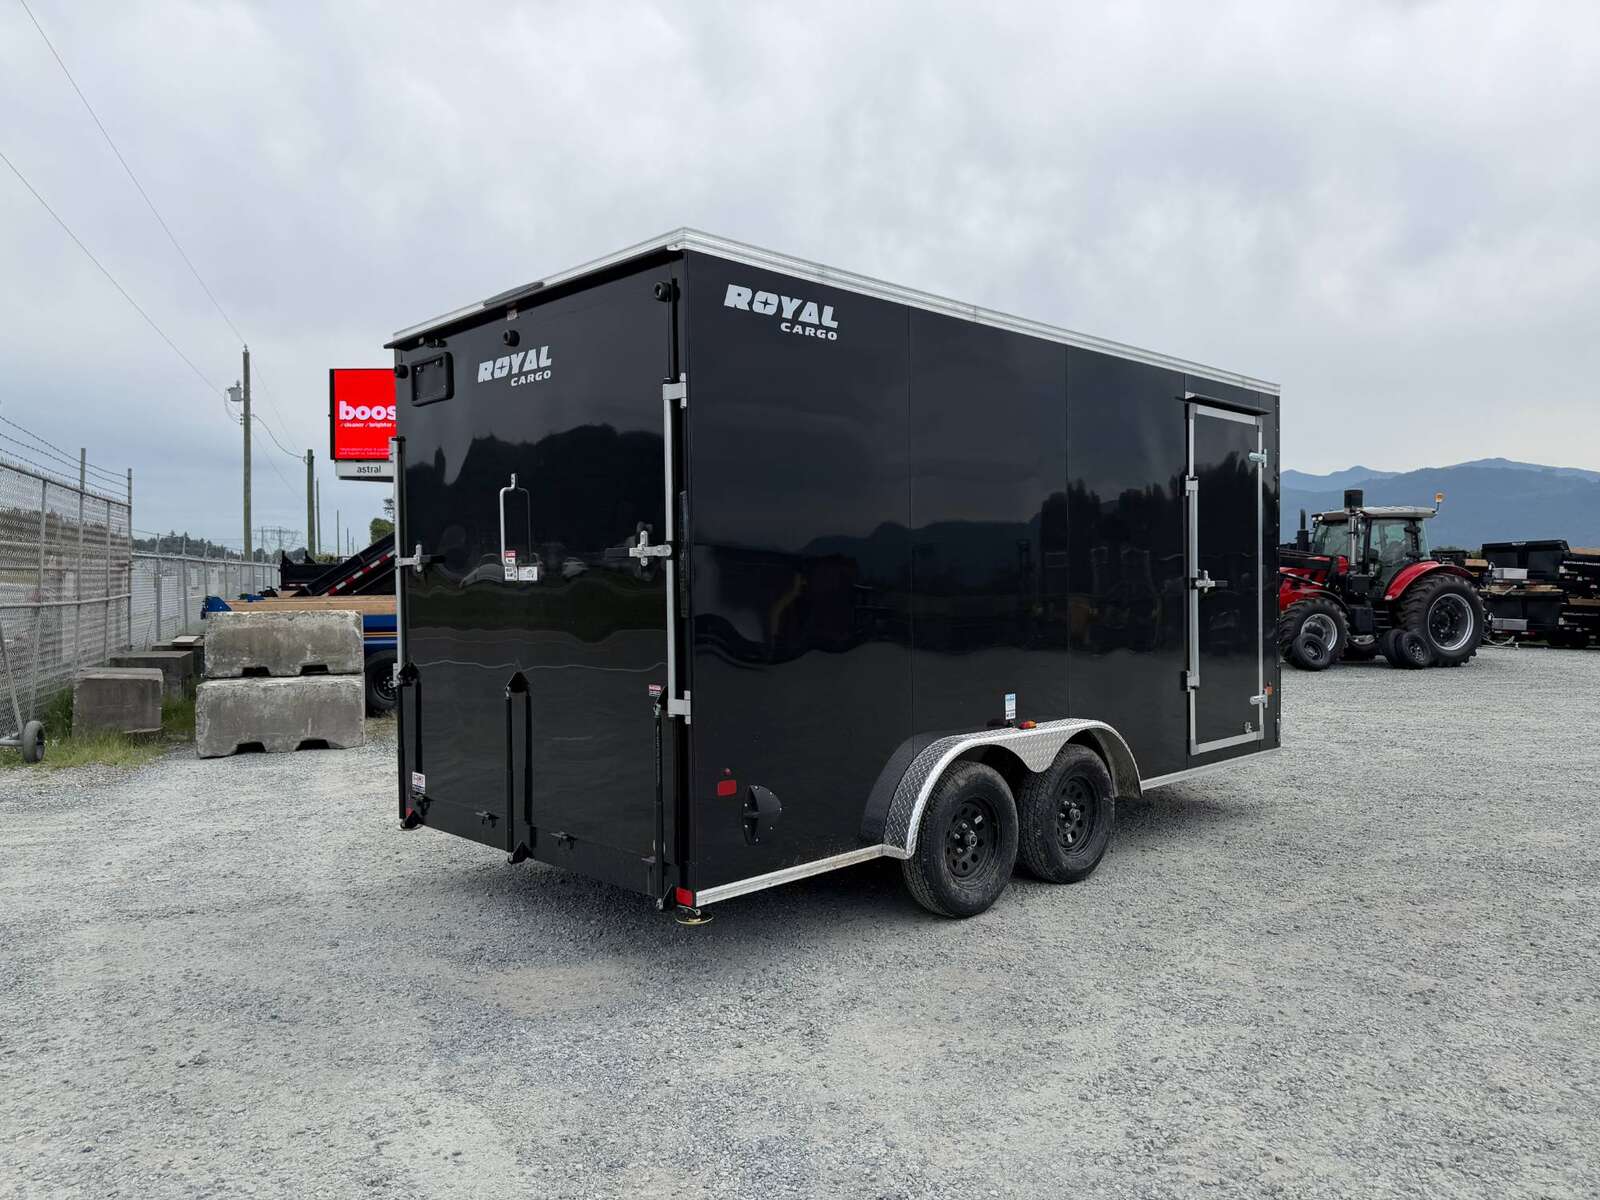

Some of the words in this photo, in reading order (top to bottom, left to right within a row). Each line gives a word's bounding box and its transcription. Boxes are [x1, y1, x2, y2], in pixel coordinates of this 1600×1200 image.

[724, 284, 838, 328] ROYAL
[780, 322, 837, 340] CARGO
[478, 346, 552, 383] ROYAL
[511, 370, 551, 386] CARGO
[357, 465, 382, 473] astral
